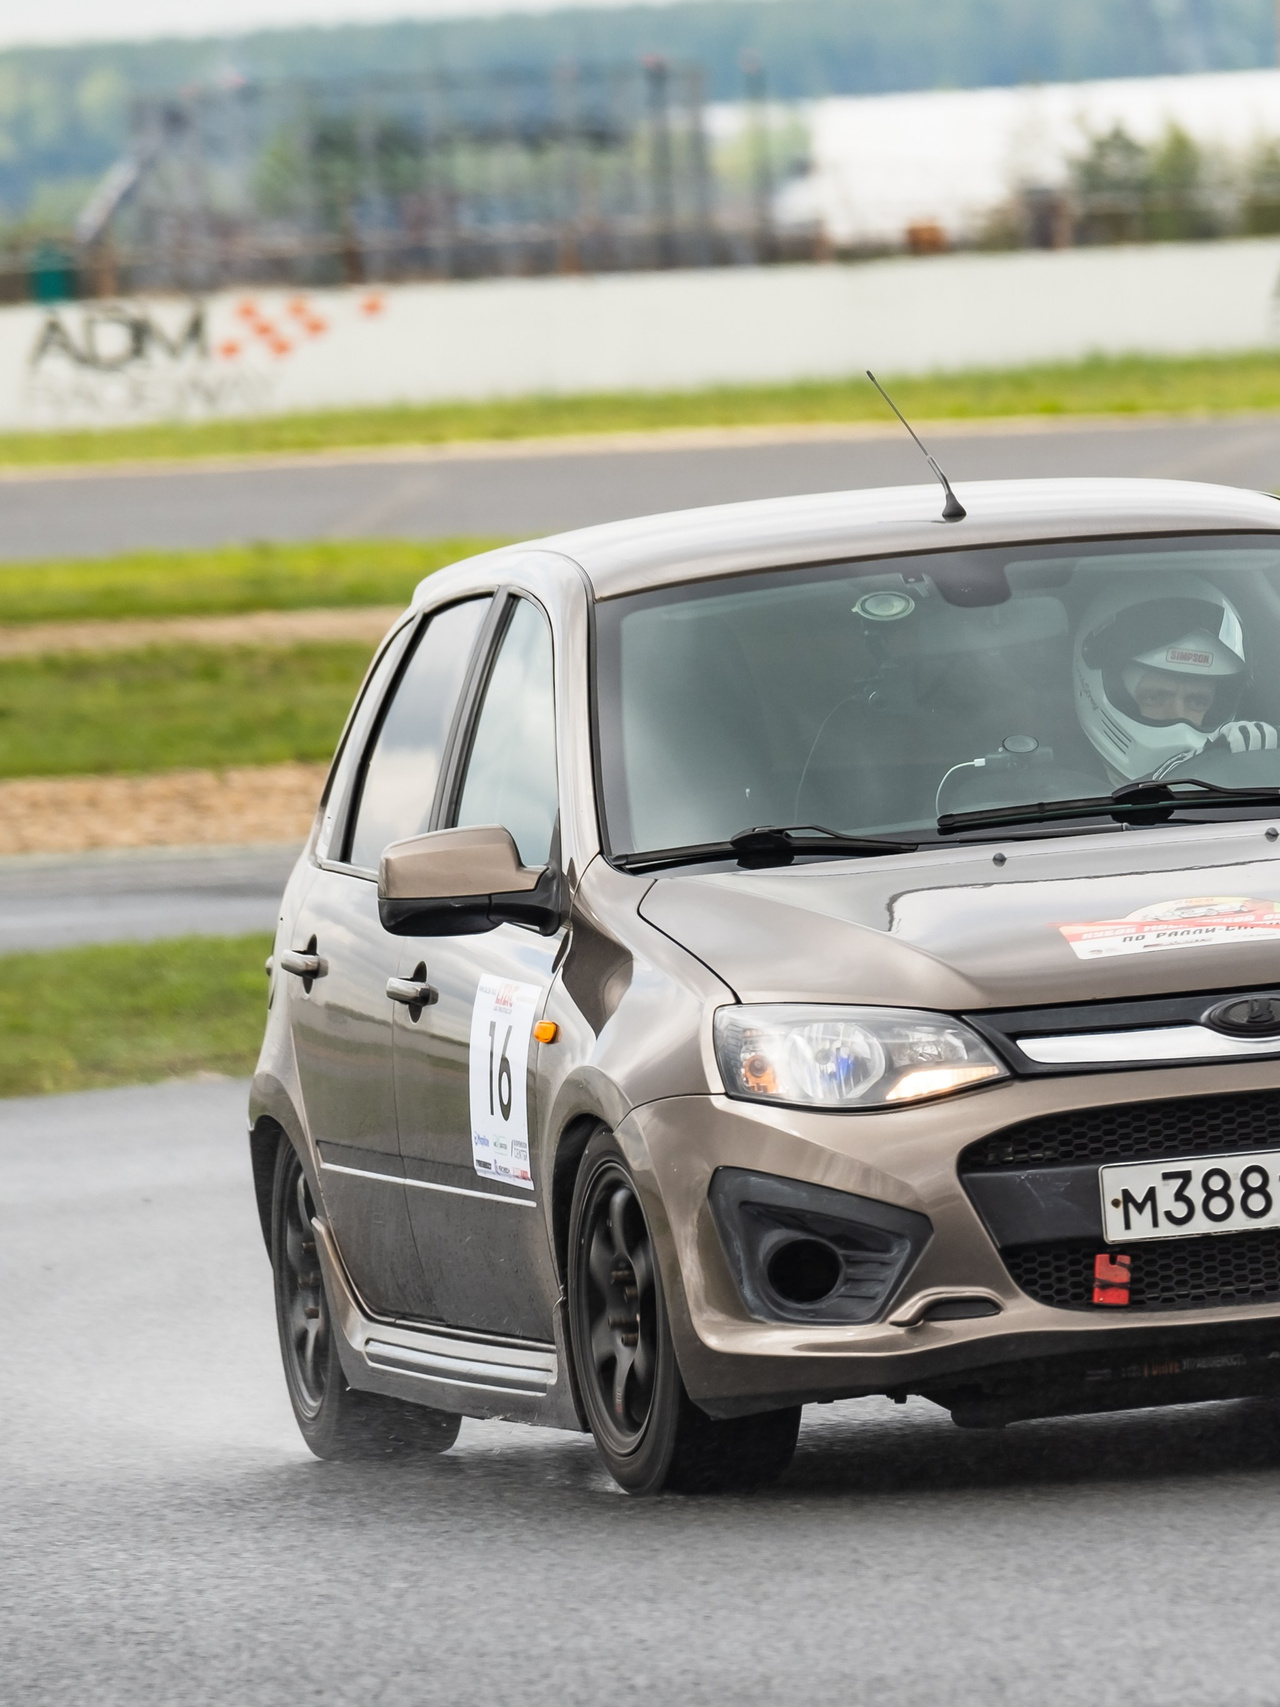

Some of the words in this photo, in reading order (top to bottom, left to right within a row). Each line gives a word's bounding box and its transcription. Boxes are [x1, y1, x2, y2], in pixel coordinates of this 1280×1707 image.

[32, 303, 207, 370] ADM
[1170, 650, 1210, 664] SIMPSON
[1122, 934, 1146, 943] ПО
[489, 1020, 513, 1122] 16
